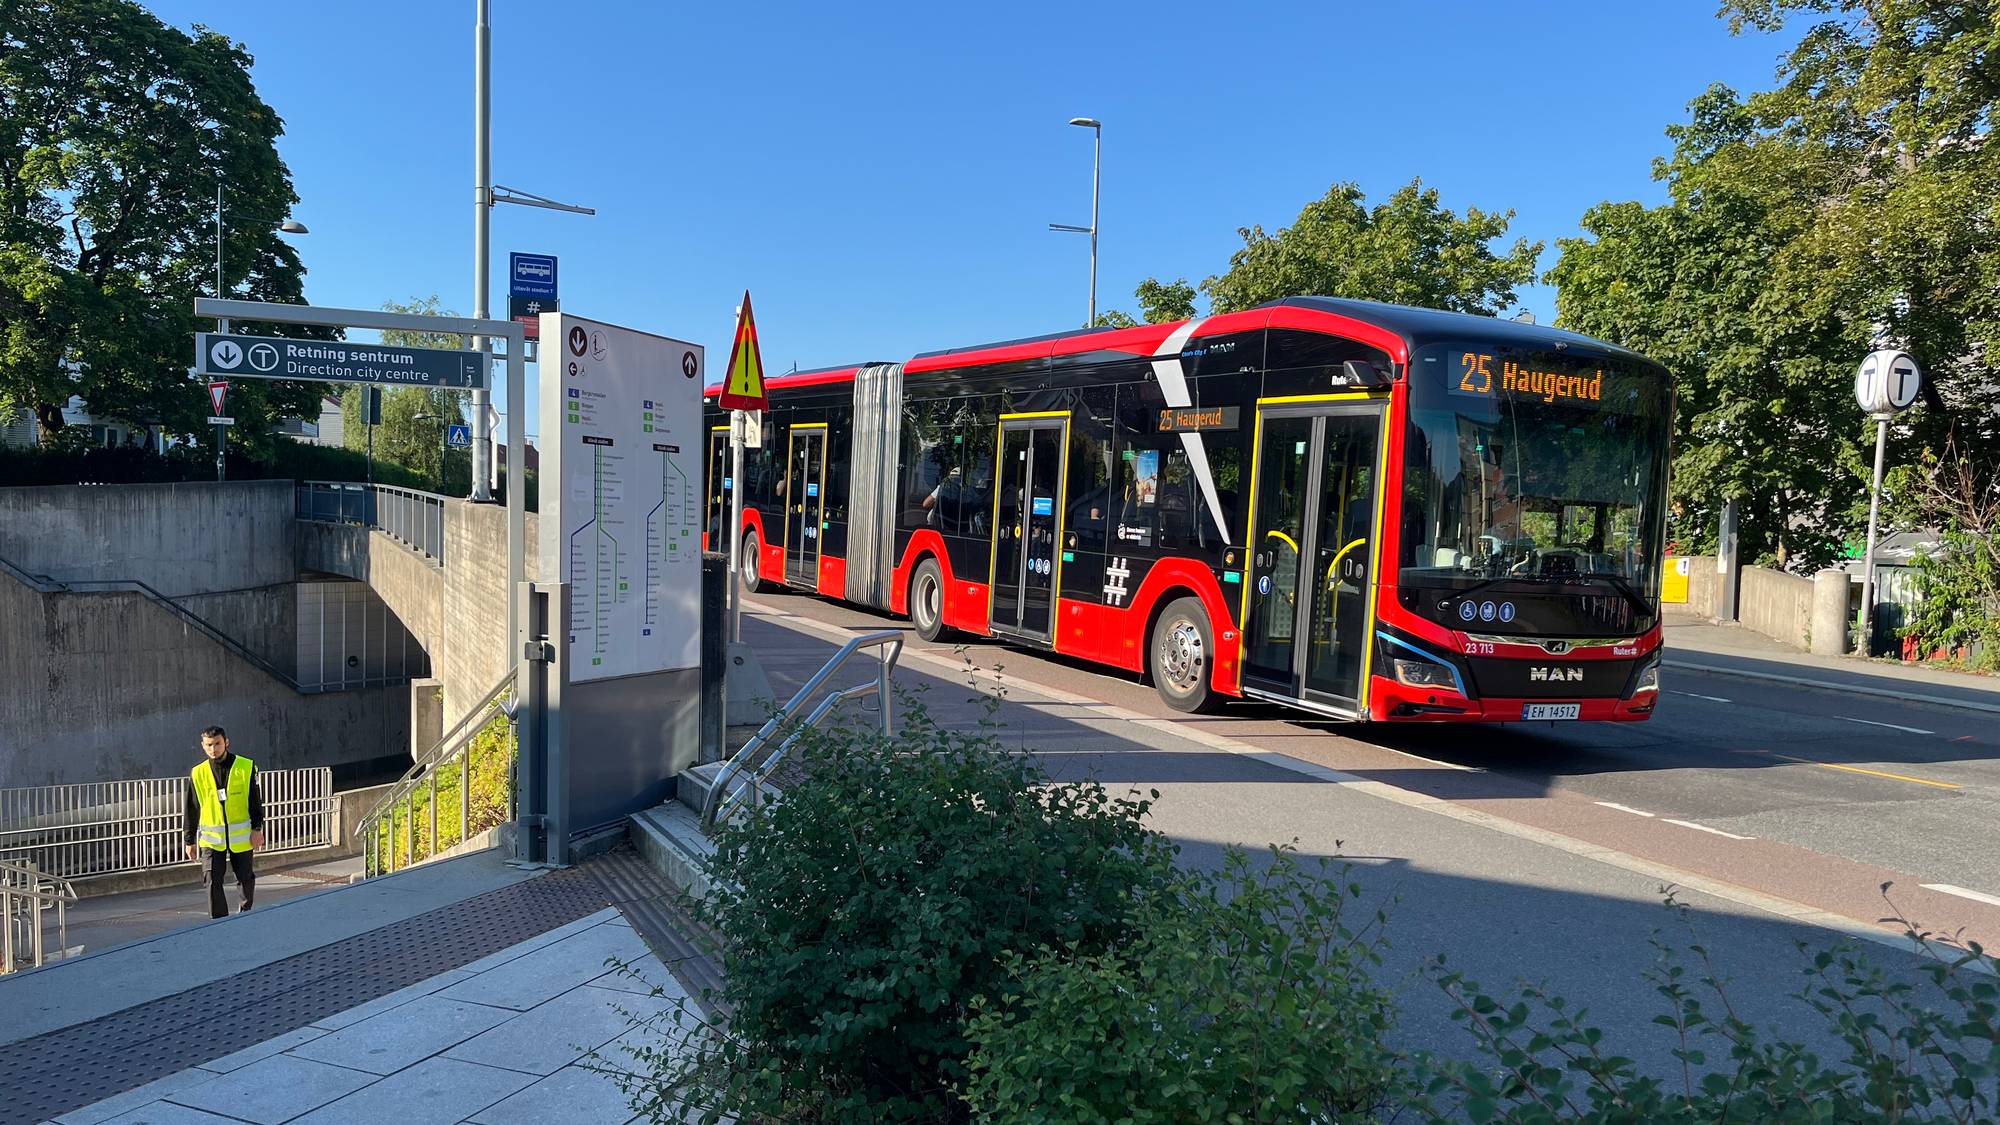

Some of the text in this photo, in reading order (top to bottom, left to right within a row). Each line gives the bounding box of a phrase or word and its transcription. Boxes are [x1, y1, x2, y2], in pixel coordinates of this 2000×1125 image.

[286, 344, 414, 365] Retning sentrum
[1209, 342, 1236, 353] MAN
[287, 361, 430, 382] Direction city centre
[1331, 375, 1348, 386] Rute
[1460, 352, 1602, 403] 25 Haugerud
[1863, 367, 1876, 401] T
[1894, 367, 1913, 401] T
[1158, 407, 1222, 432] 25 Haugerud
[1465, 642, 1494, 654] 23 713
[1530, 667, 1584, 681] MAN
[1531, 706, 1576, 718] EH 14512
